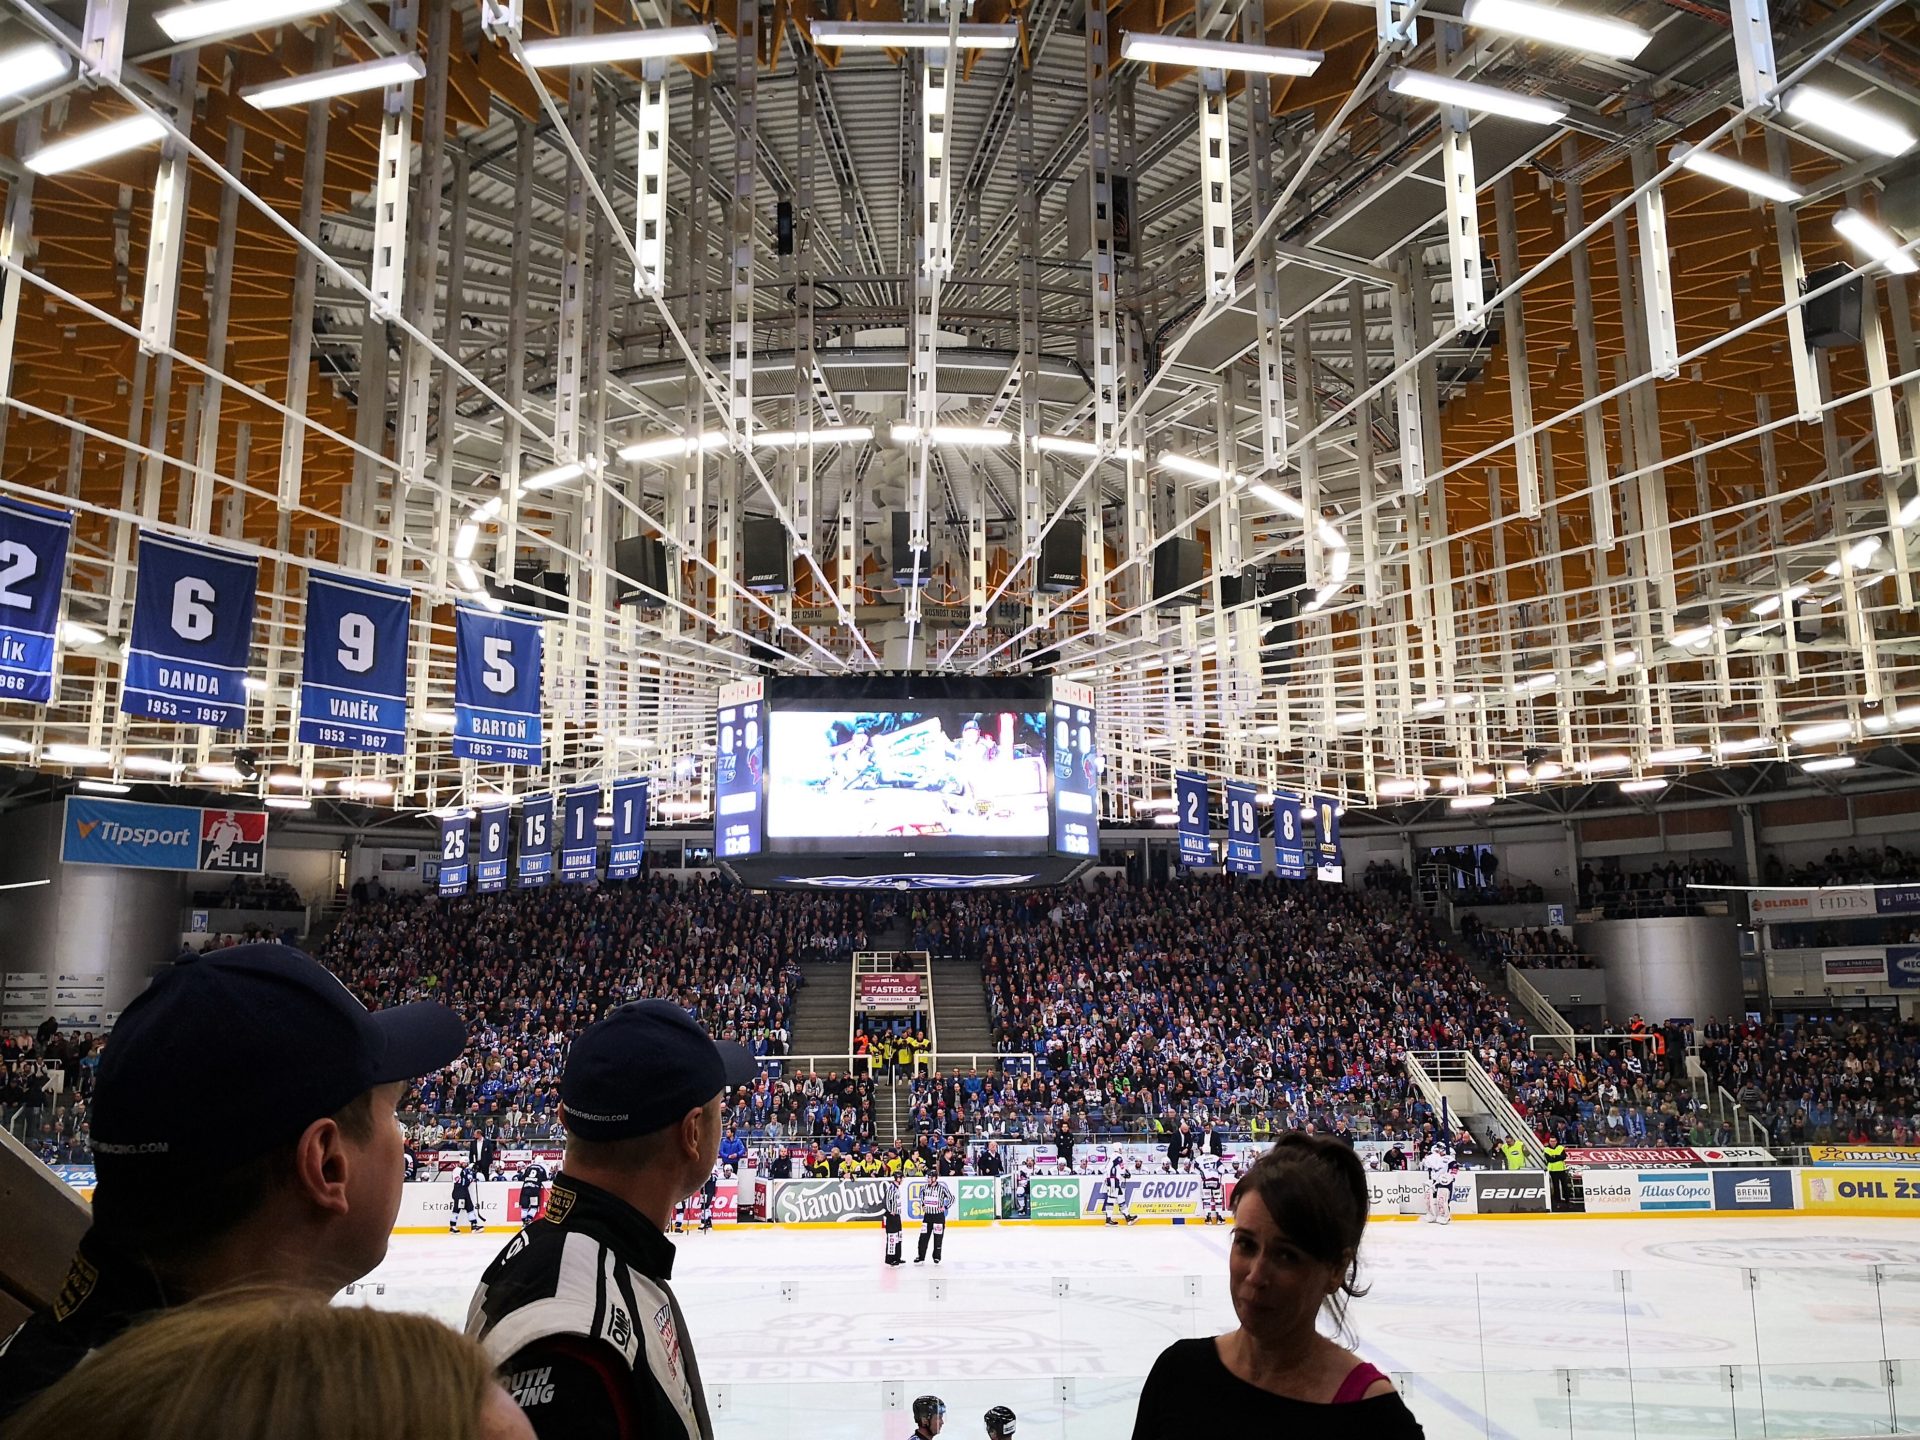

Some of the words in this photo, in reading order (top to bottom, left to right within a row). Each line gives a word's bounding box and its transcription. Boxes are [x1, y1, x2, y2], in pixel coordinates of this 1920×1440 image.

[0, 540, 37, 610] 2
[747, 573, 778, 582] BOSE
[1049, 573, 1079, 581] BOSE
[171, 576, 216, 641] 6
[802, 610, 814, 618] 1250
[951, 608, 962, 618] 1250
[337, 612, 375, 673] 9
[482, 636, 515, 694] 5
[158, 667, 219, 696] DANDA
[147, 699, 177, 717] 1953
[197, 707, 228, 724] 1967
[330, 698, 380, 722] VANĚK
[319, 728, 345, 743] 1953
[361, 733, 387, 748] 1967
[472, 717, 527, 739] BARTOŇ
[469, 742, 493, 756] 1953
[507, 746, 529, 760] 1962
[623, 799, 633, 835] 1
[1187, 791, 1199, 825] 2
[1231, 800, 1254, 834] 19
[526, 814, 546, 848] 15
[575, 806, 584, 840] 1
[1282, 809, 1294, 841] 8
[101, 821, 191, 848] Tipsport
[443, 829, 465, 860] 25
[488, 822, 500, 853] 6
[217, 851, 258, 868] ELH
[1819, 895, 1868, 910] FIDES
[871, 985, 917, 994] FASTER.CZ
[1589, 1150, 1697, 1162] GENERALI
[1722, 1149, 1764, 1158] BPA
[1031, 1184, 1079, 1199] GRO
[1142, 1181, 1199, 1199] GROUP
[1585, 1185, 1631, 1196] askáda
[1640, 1184, 1675, 1197] Atlas
[1676, 1184, 1711, 1198] Copco
[1737, 1188, 1769, 1196] BRENNA
[1838, 1181, 1888, 1198] OHL
[612, 1308, 629, 1347] OMP
